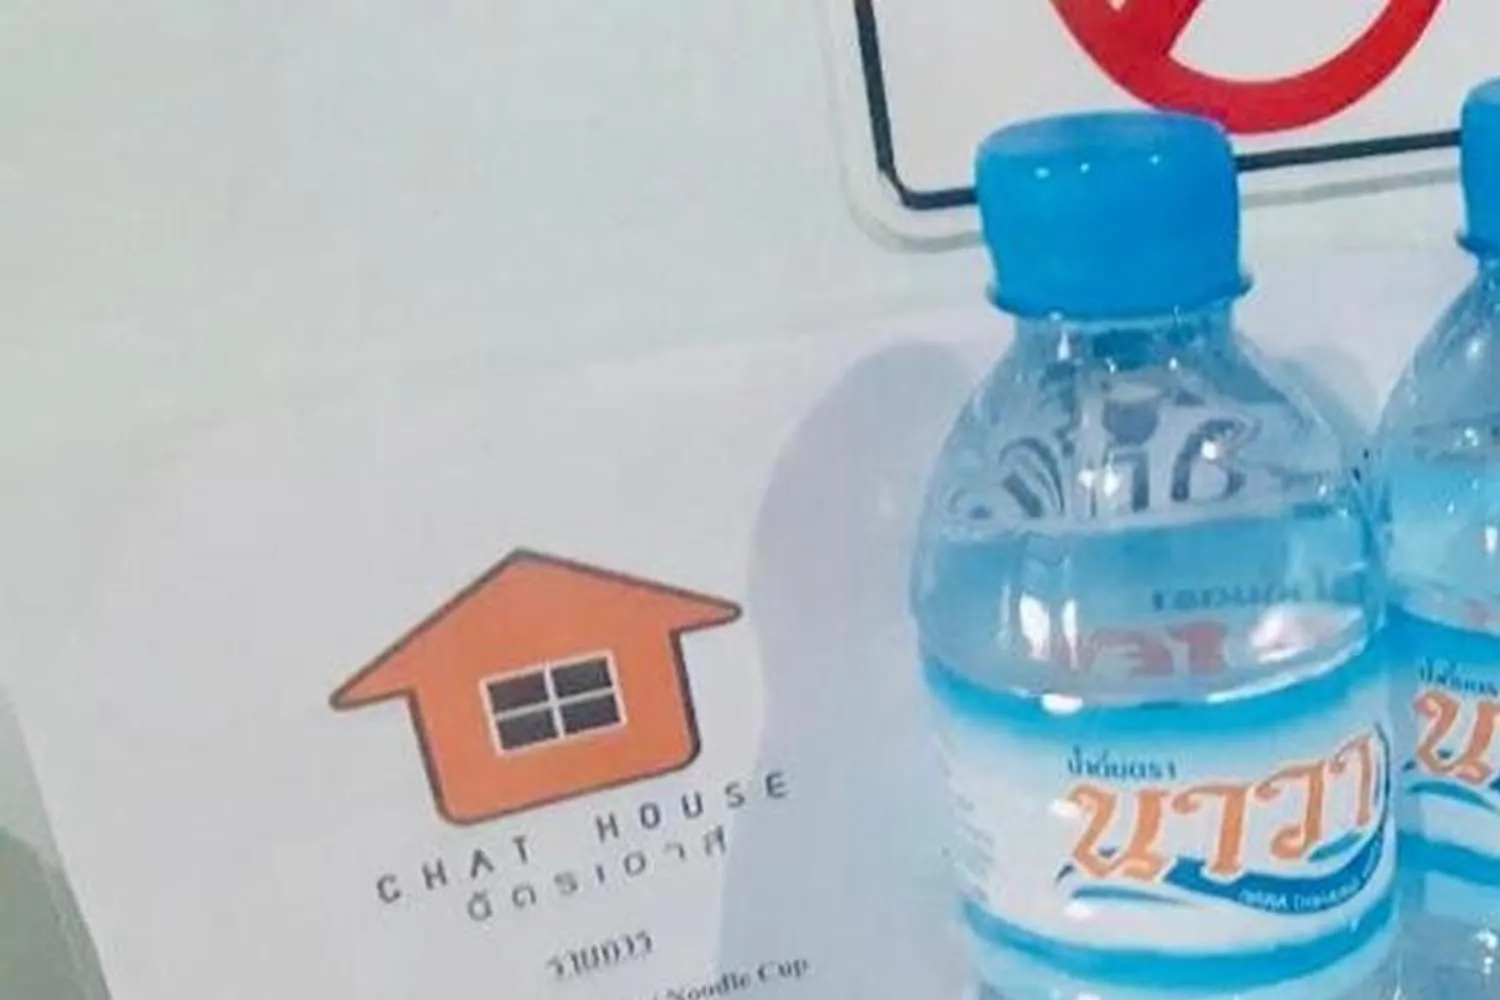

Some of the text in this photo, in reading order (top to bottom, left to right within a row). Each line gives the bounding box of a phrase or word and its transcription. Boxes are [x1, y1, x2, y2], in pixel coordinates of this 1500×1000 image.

[376, 771, 790, 904] CHAT HOUSE
[1063, 736, 1375, 882] นาวา
[546, 929, 654, 980] รายการ
[757, 957, 810, 983] Cup
